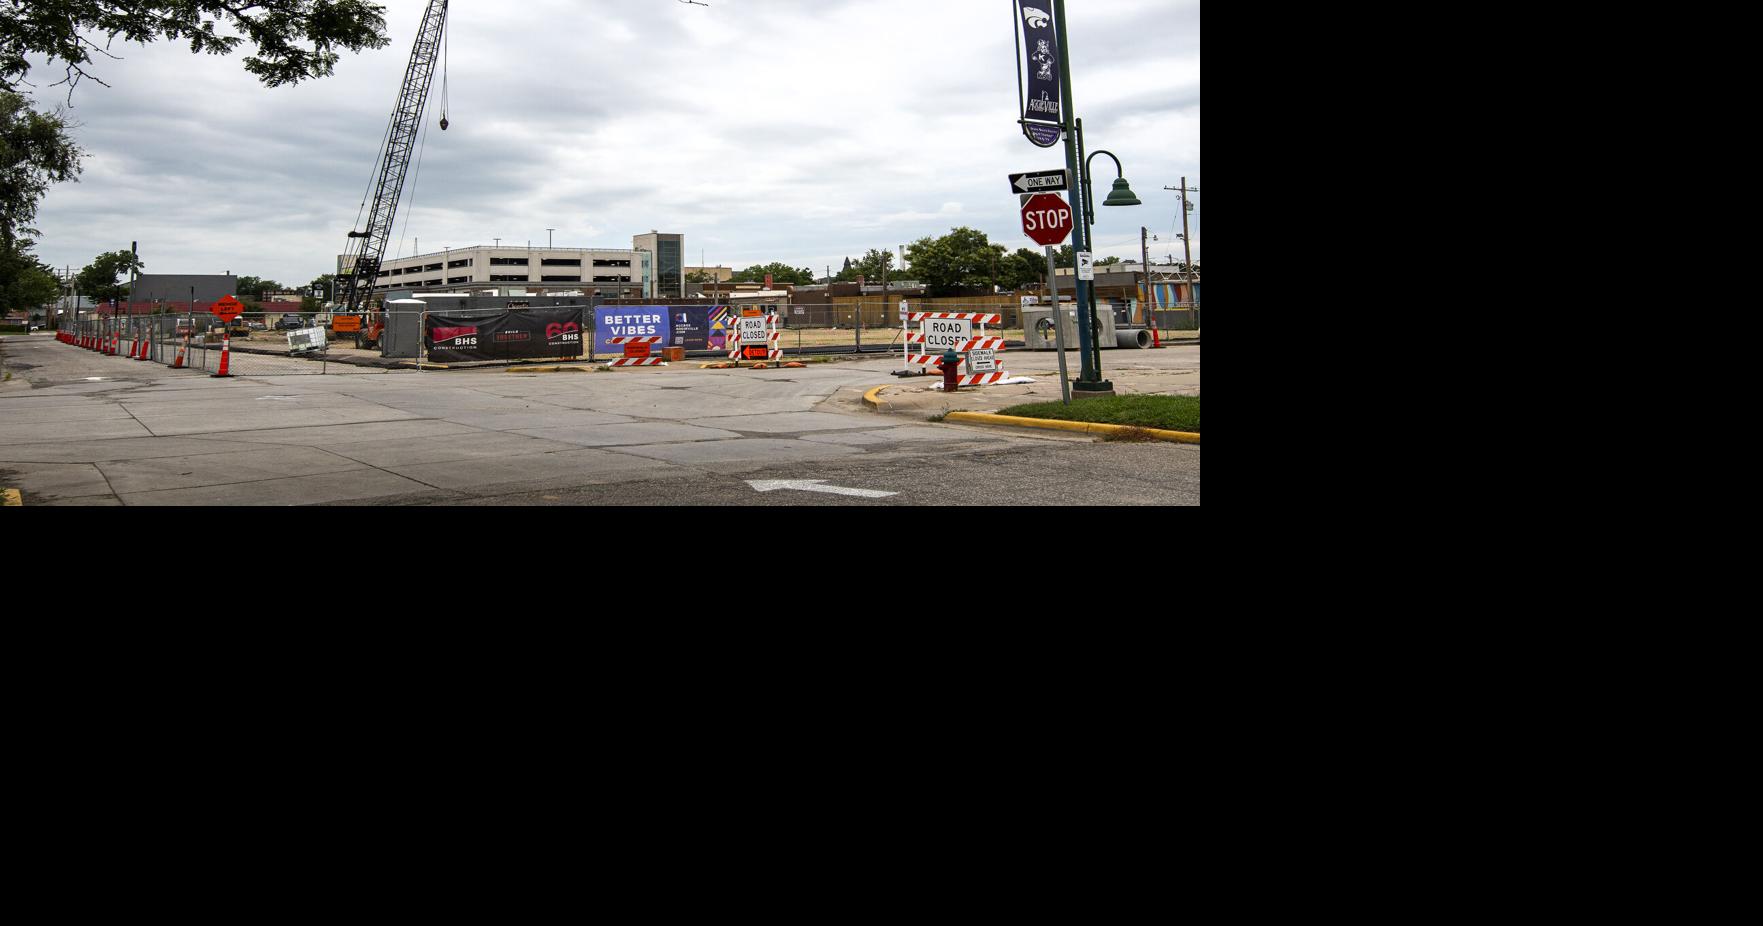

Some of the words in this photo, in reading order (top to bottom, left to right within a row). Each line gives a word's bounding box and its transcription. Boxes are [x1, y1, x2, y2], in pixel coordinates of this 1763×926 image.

[1028, 177, 1043, 186] ONE
[1045, 176, 1060, 185] WAY
[1025, 208, 1069, 231] STOP
[604, 314, 661, 325] BETTER
[745, 320, 761, 329] ROAD
[610, 325, 656, 335] VIBES
[932, 322, 962, 333] ROAD
[562, 333, 579, 341] BHS
[742, 330, 765, 339] CLOSED
[455, 337, 478, 345] BHS
